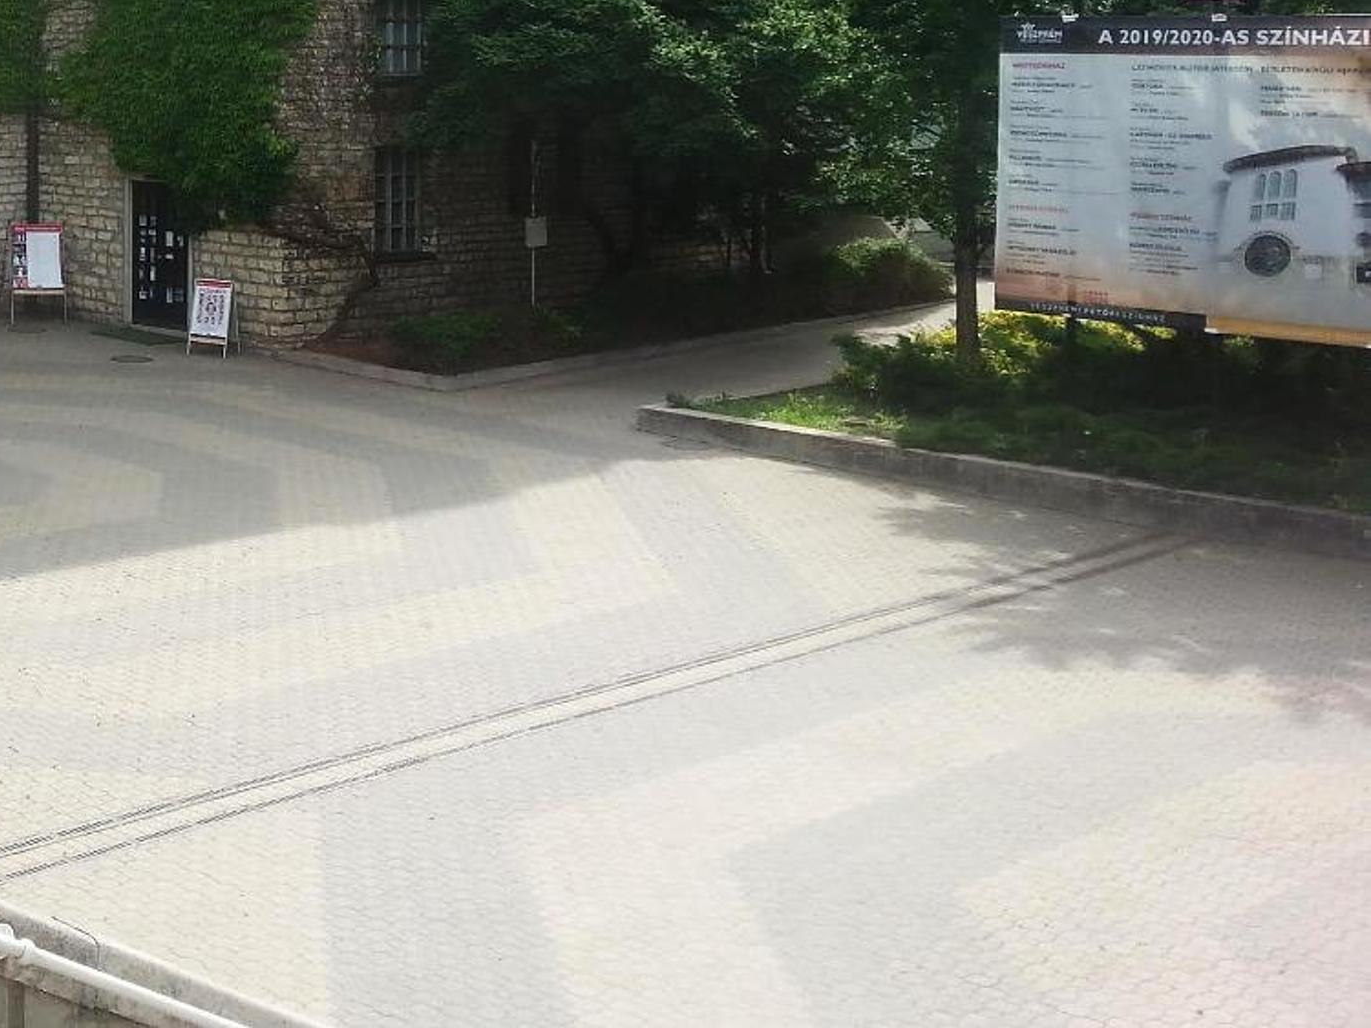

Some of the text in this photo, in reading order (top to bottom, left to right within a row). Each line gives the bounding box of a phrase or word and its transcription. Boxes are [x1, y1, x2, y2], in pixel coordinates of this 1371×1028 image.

[1097, 26, 1370, 46] A 2019/2020-AS SZÍNHÁZI
